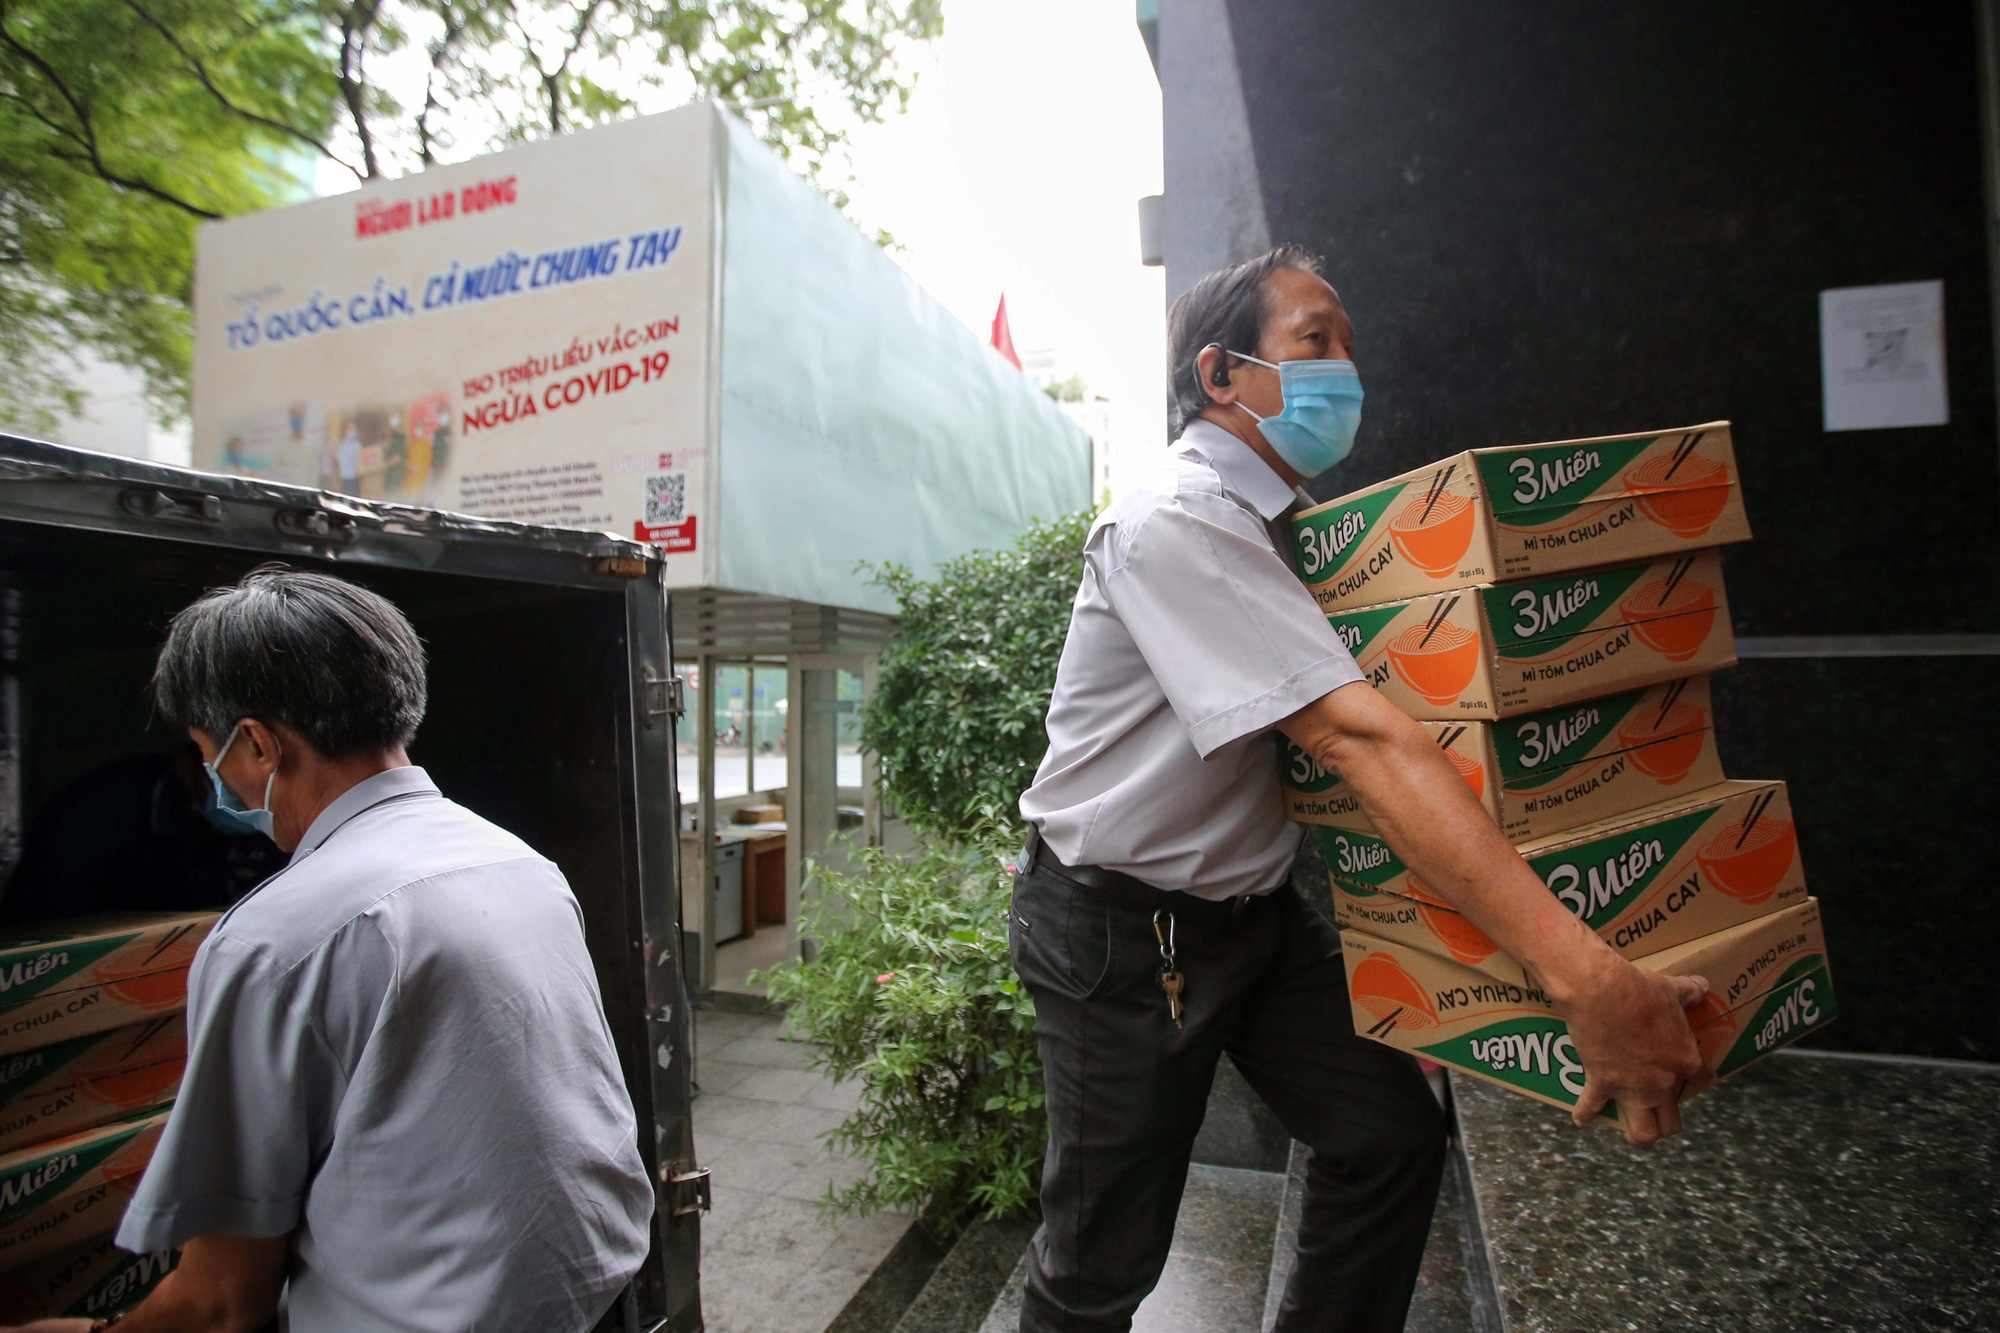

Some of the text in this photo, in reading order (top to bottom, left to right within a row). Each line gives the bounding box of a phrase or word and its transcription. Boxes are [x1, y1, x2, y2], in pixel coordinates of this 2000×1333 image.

[419, 191, 455, 224] LAO
[266, 290, 342, 340] QUỐC
[530, 239, 620, 288] CHUNG
[626, 226, 681, 270] TAY
[463, 375, 494, 398] 150
[544, 351, 670, 410] COVID-19
[661, 528, 679, 538] CODE
[1524, 503, 1635, 550] MÌ TÔM CHUA CAY
[1318, 542, 1394, 605] TÔM CHUA CAY
[1522, 629, 1630, 682] MÌ TÔM CHUA CAY
[1525, 757, 1625, 813] MÌ TÔM CHUA CAY
[1293, 800, 1306, 814] MÌ
[1306, 801, 1328, 816] TÔM
[1355, 906, 1370, 920] TÔM
[1371, 910, 1397, 924] CHUA
[1397, 907, 1418, 925] CAY
[1615, 871, 1702, 948] CHUA CAY
[1776, 939, 1797, 954] TÔM
[1748, 948, 1777, 978] CHUA
[1436, 987, 1469, 1012] CAY
[1469, 985, 1522, 1003] CHUA
[1727, 975, 1749, 1005] CAY
[13, 990, 101, 1034] CHUA CAY
[41, 1091, 76, 1118] CAY
[20, 1184, 108, 1241] CHUA CAY
